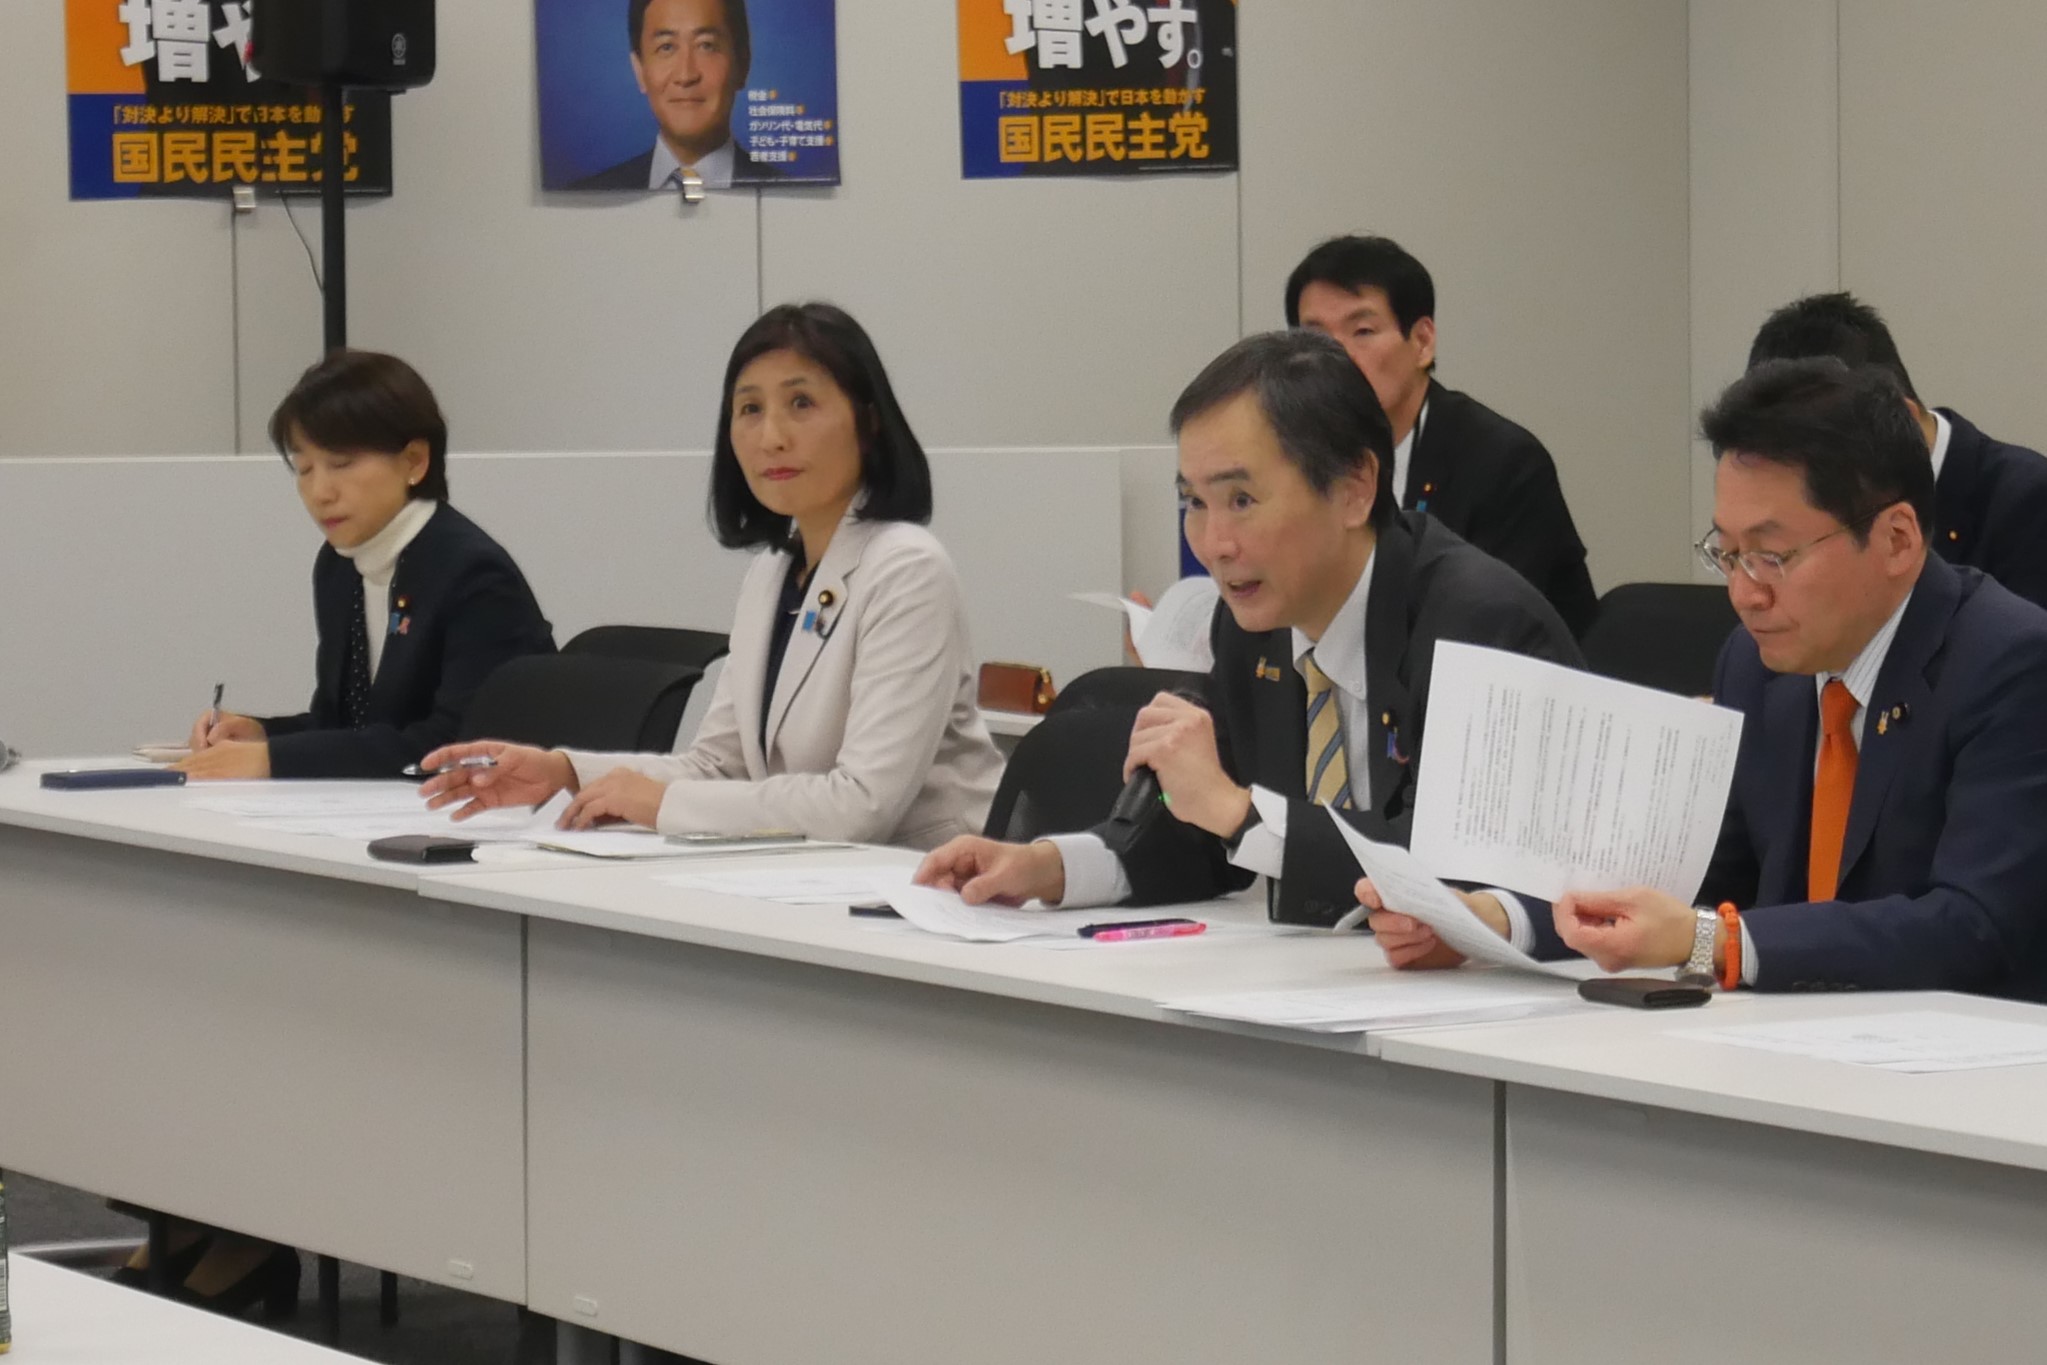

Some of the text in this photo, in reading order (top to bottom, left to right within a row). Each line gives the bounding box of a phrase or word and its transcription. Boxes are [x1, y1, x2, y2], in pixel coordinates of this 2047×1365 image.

[1003, 0, 1203, 69] 増やす。
[1000, 88, 1206, 109] 「対決より解決」で日本を動かす
[113, 104, 355, 125] 「対決より解決」で日本を動す
[749, 120, 823, 132] ガソリン代・電気代
[749, 135, 825, 147] 子ども・子育て支援
[998, 112, 1209, 163] 国民民主党
